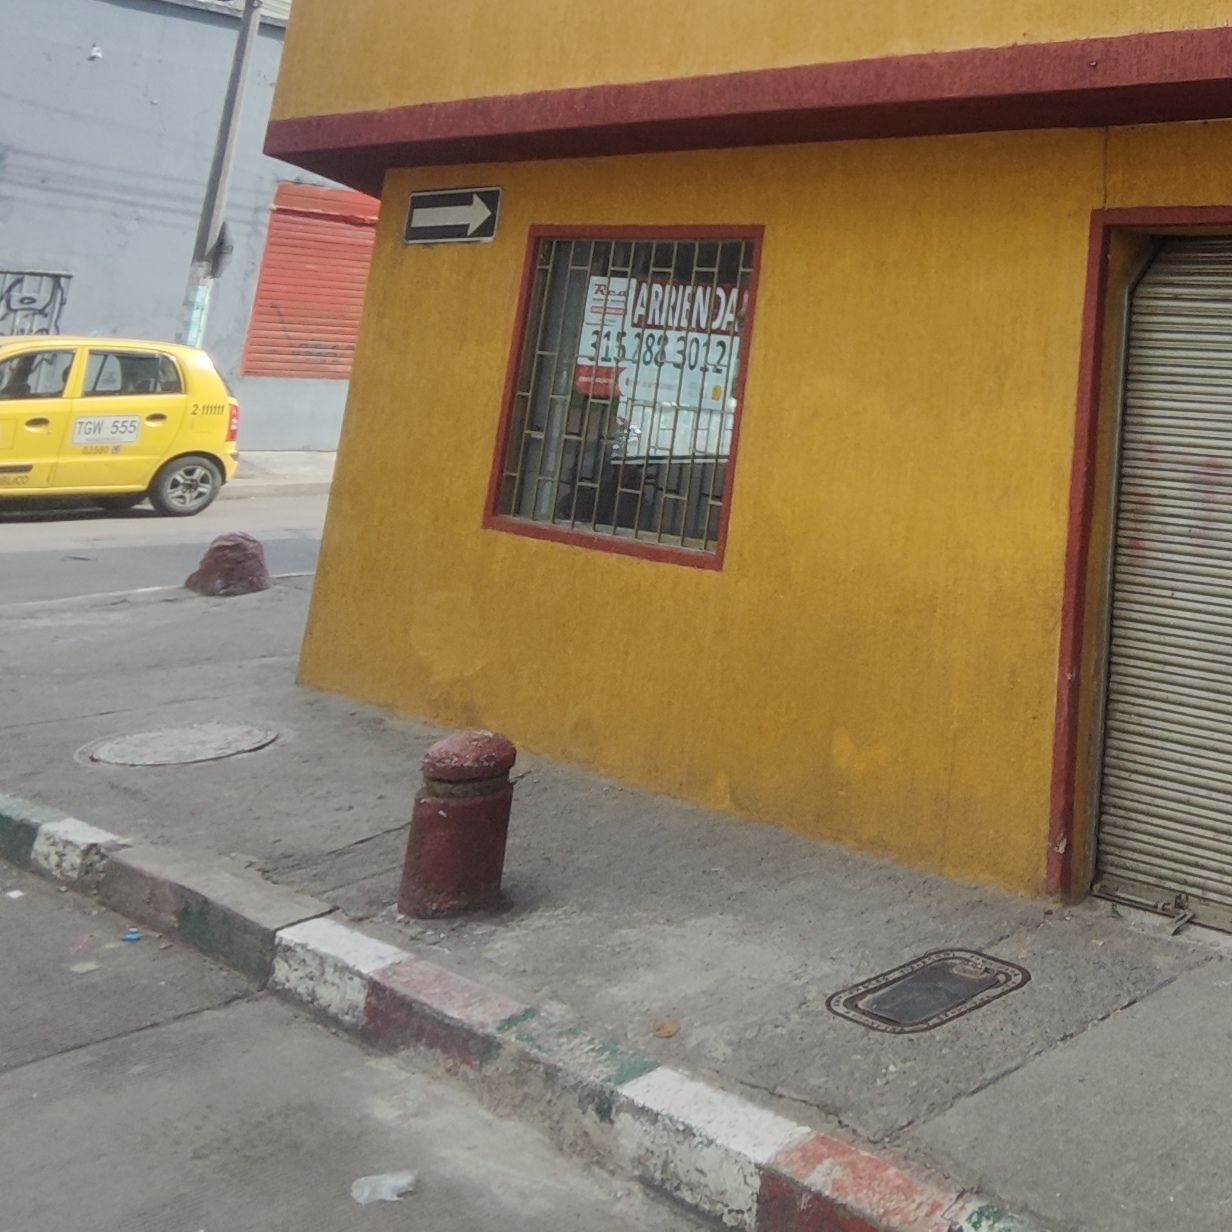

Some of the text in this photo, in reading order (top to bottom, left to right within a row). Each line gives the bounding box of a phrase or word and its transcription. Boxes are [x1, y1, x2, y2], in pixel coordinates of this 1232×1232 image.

[633, 282, 740, 333] ARRIENDA
[591, 329, 627, 363] 315
[77, 419, 137, 436] TGW 555
